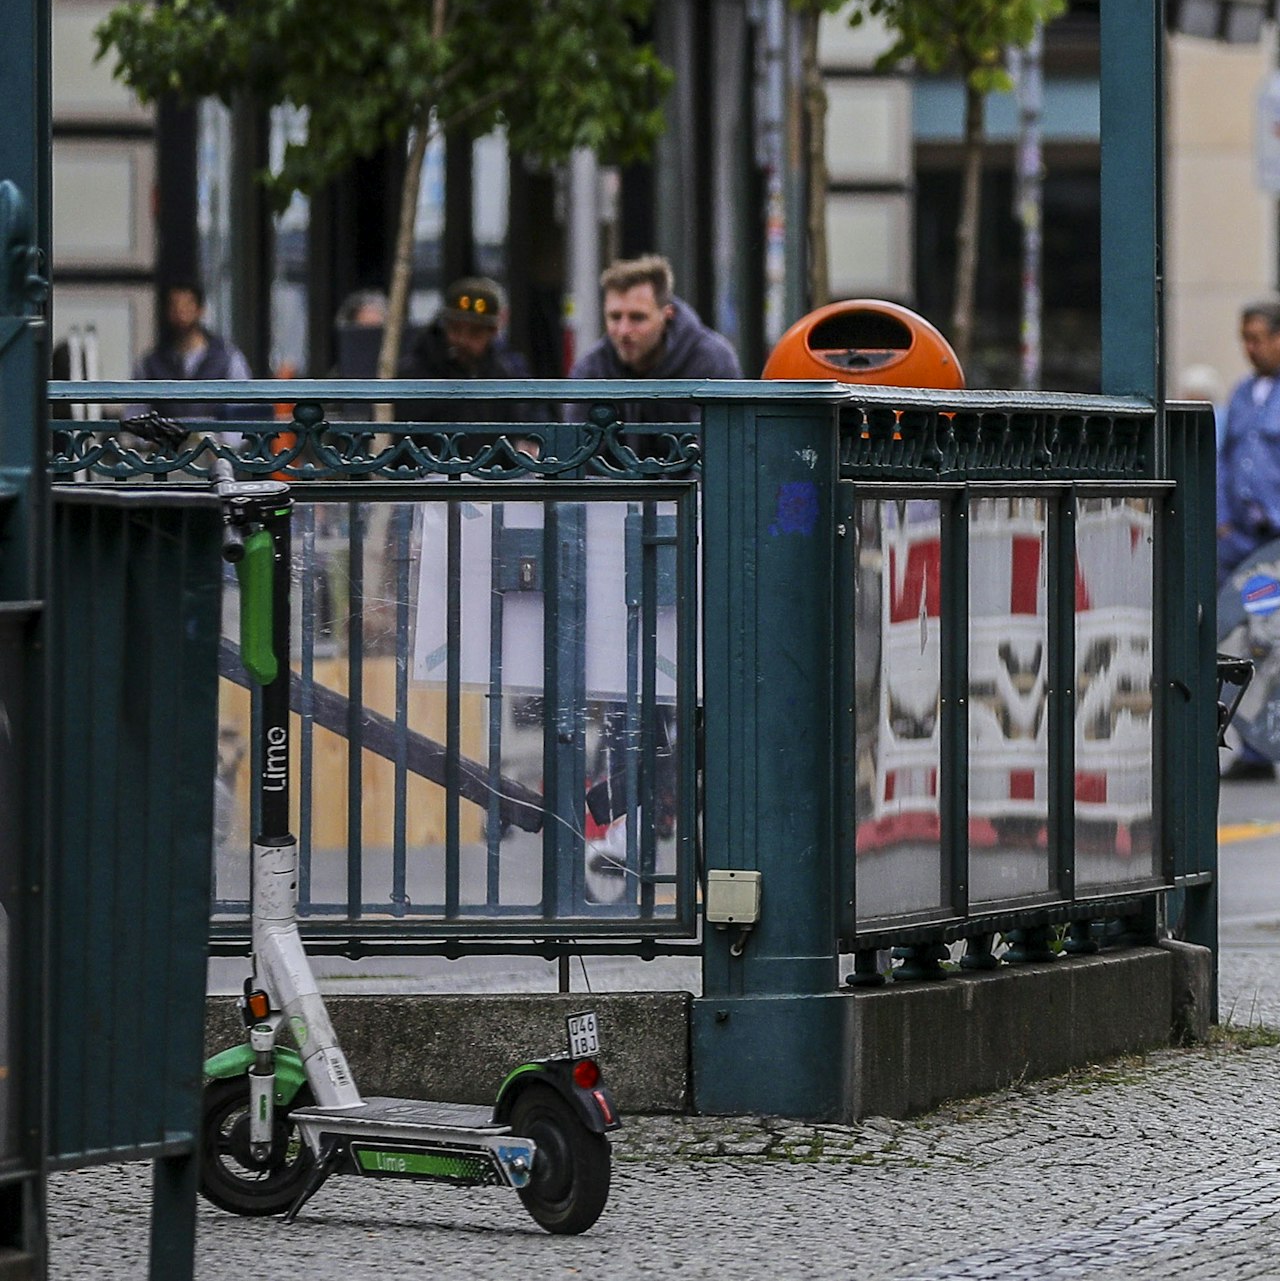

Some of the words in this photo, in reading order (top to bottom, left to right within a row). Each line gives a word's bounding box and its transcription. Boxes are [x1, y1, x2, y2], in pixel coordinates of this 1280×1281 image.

[570, 1015, 594, 1036] 046
[574, 1035, 597, 1055] IBJ
[376, 1151, 406, 1172] Lime
